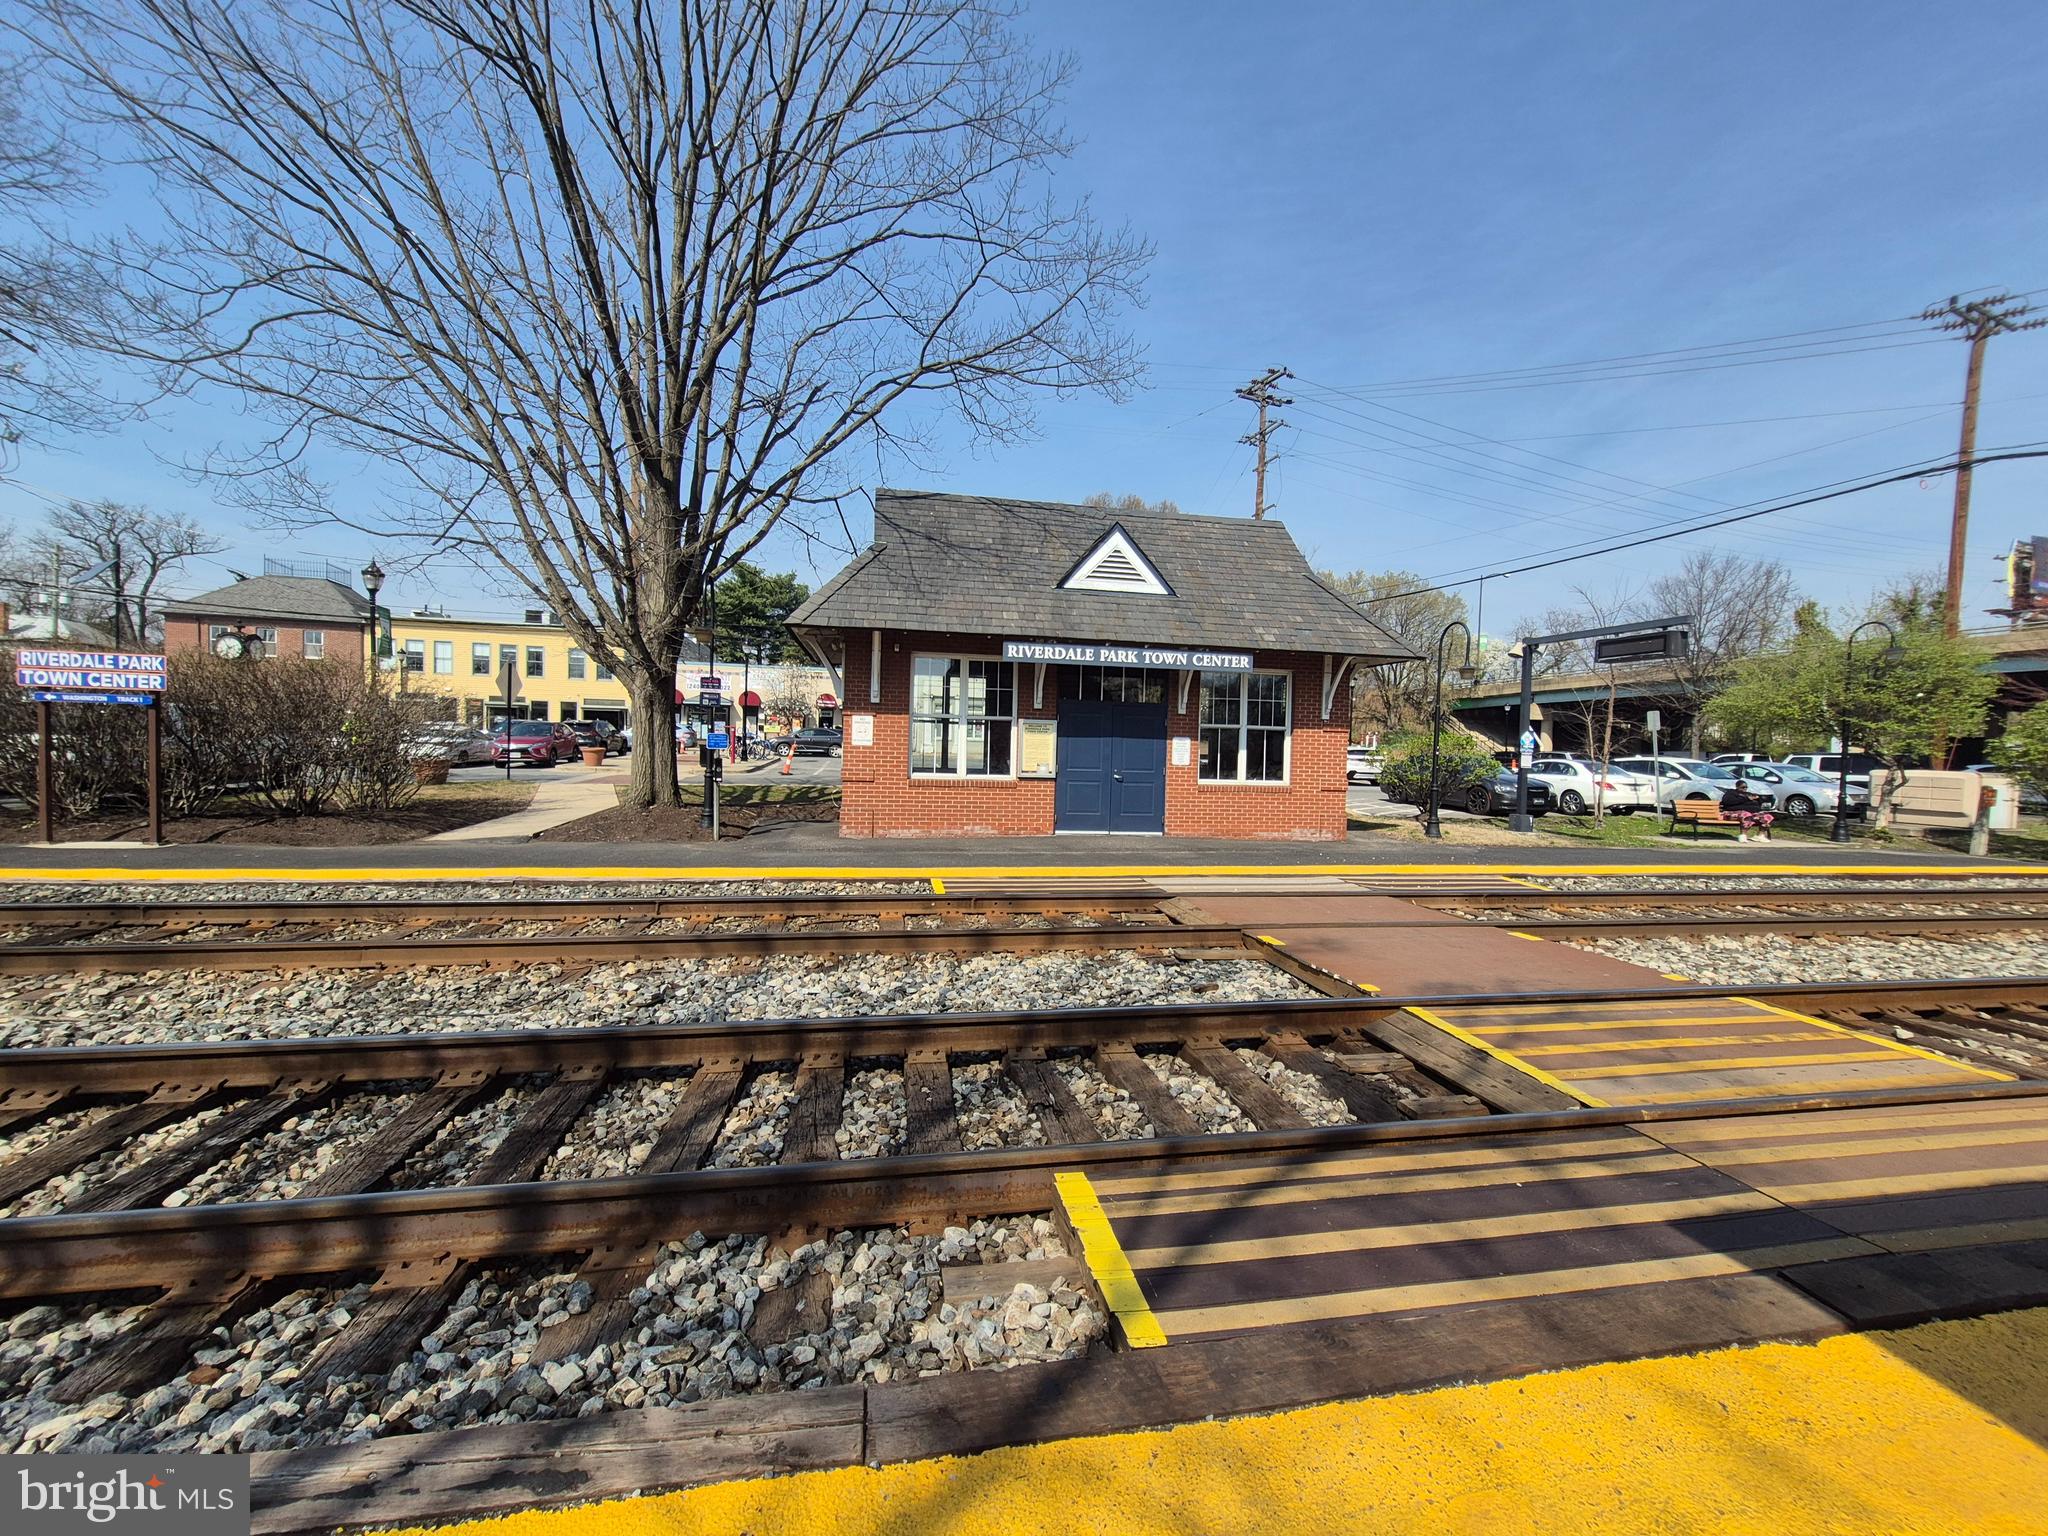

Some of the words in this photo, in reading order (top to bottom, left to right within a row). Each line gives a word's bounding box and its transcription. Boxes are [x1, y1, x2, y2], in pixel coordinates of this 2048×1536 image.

[20, 651, 115, 669] RIVERDALE
[118, 655, 164, 671] PARK
[1007, 645, 1095, 661] RIVERDALE
[1100, 649, 1138, 664] PARK
[1143, 651, 1188, 666] TOWN
[1192, 653, 1250, 669] CENTER
[21, 669, 82, 686] TOWN
[87, 673, 162, 689] CENTER
[62, 694, 108, 702] WASHINGTON
